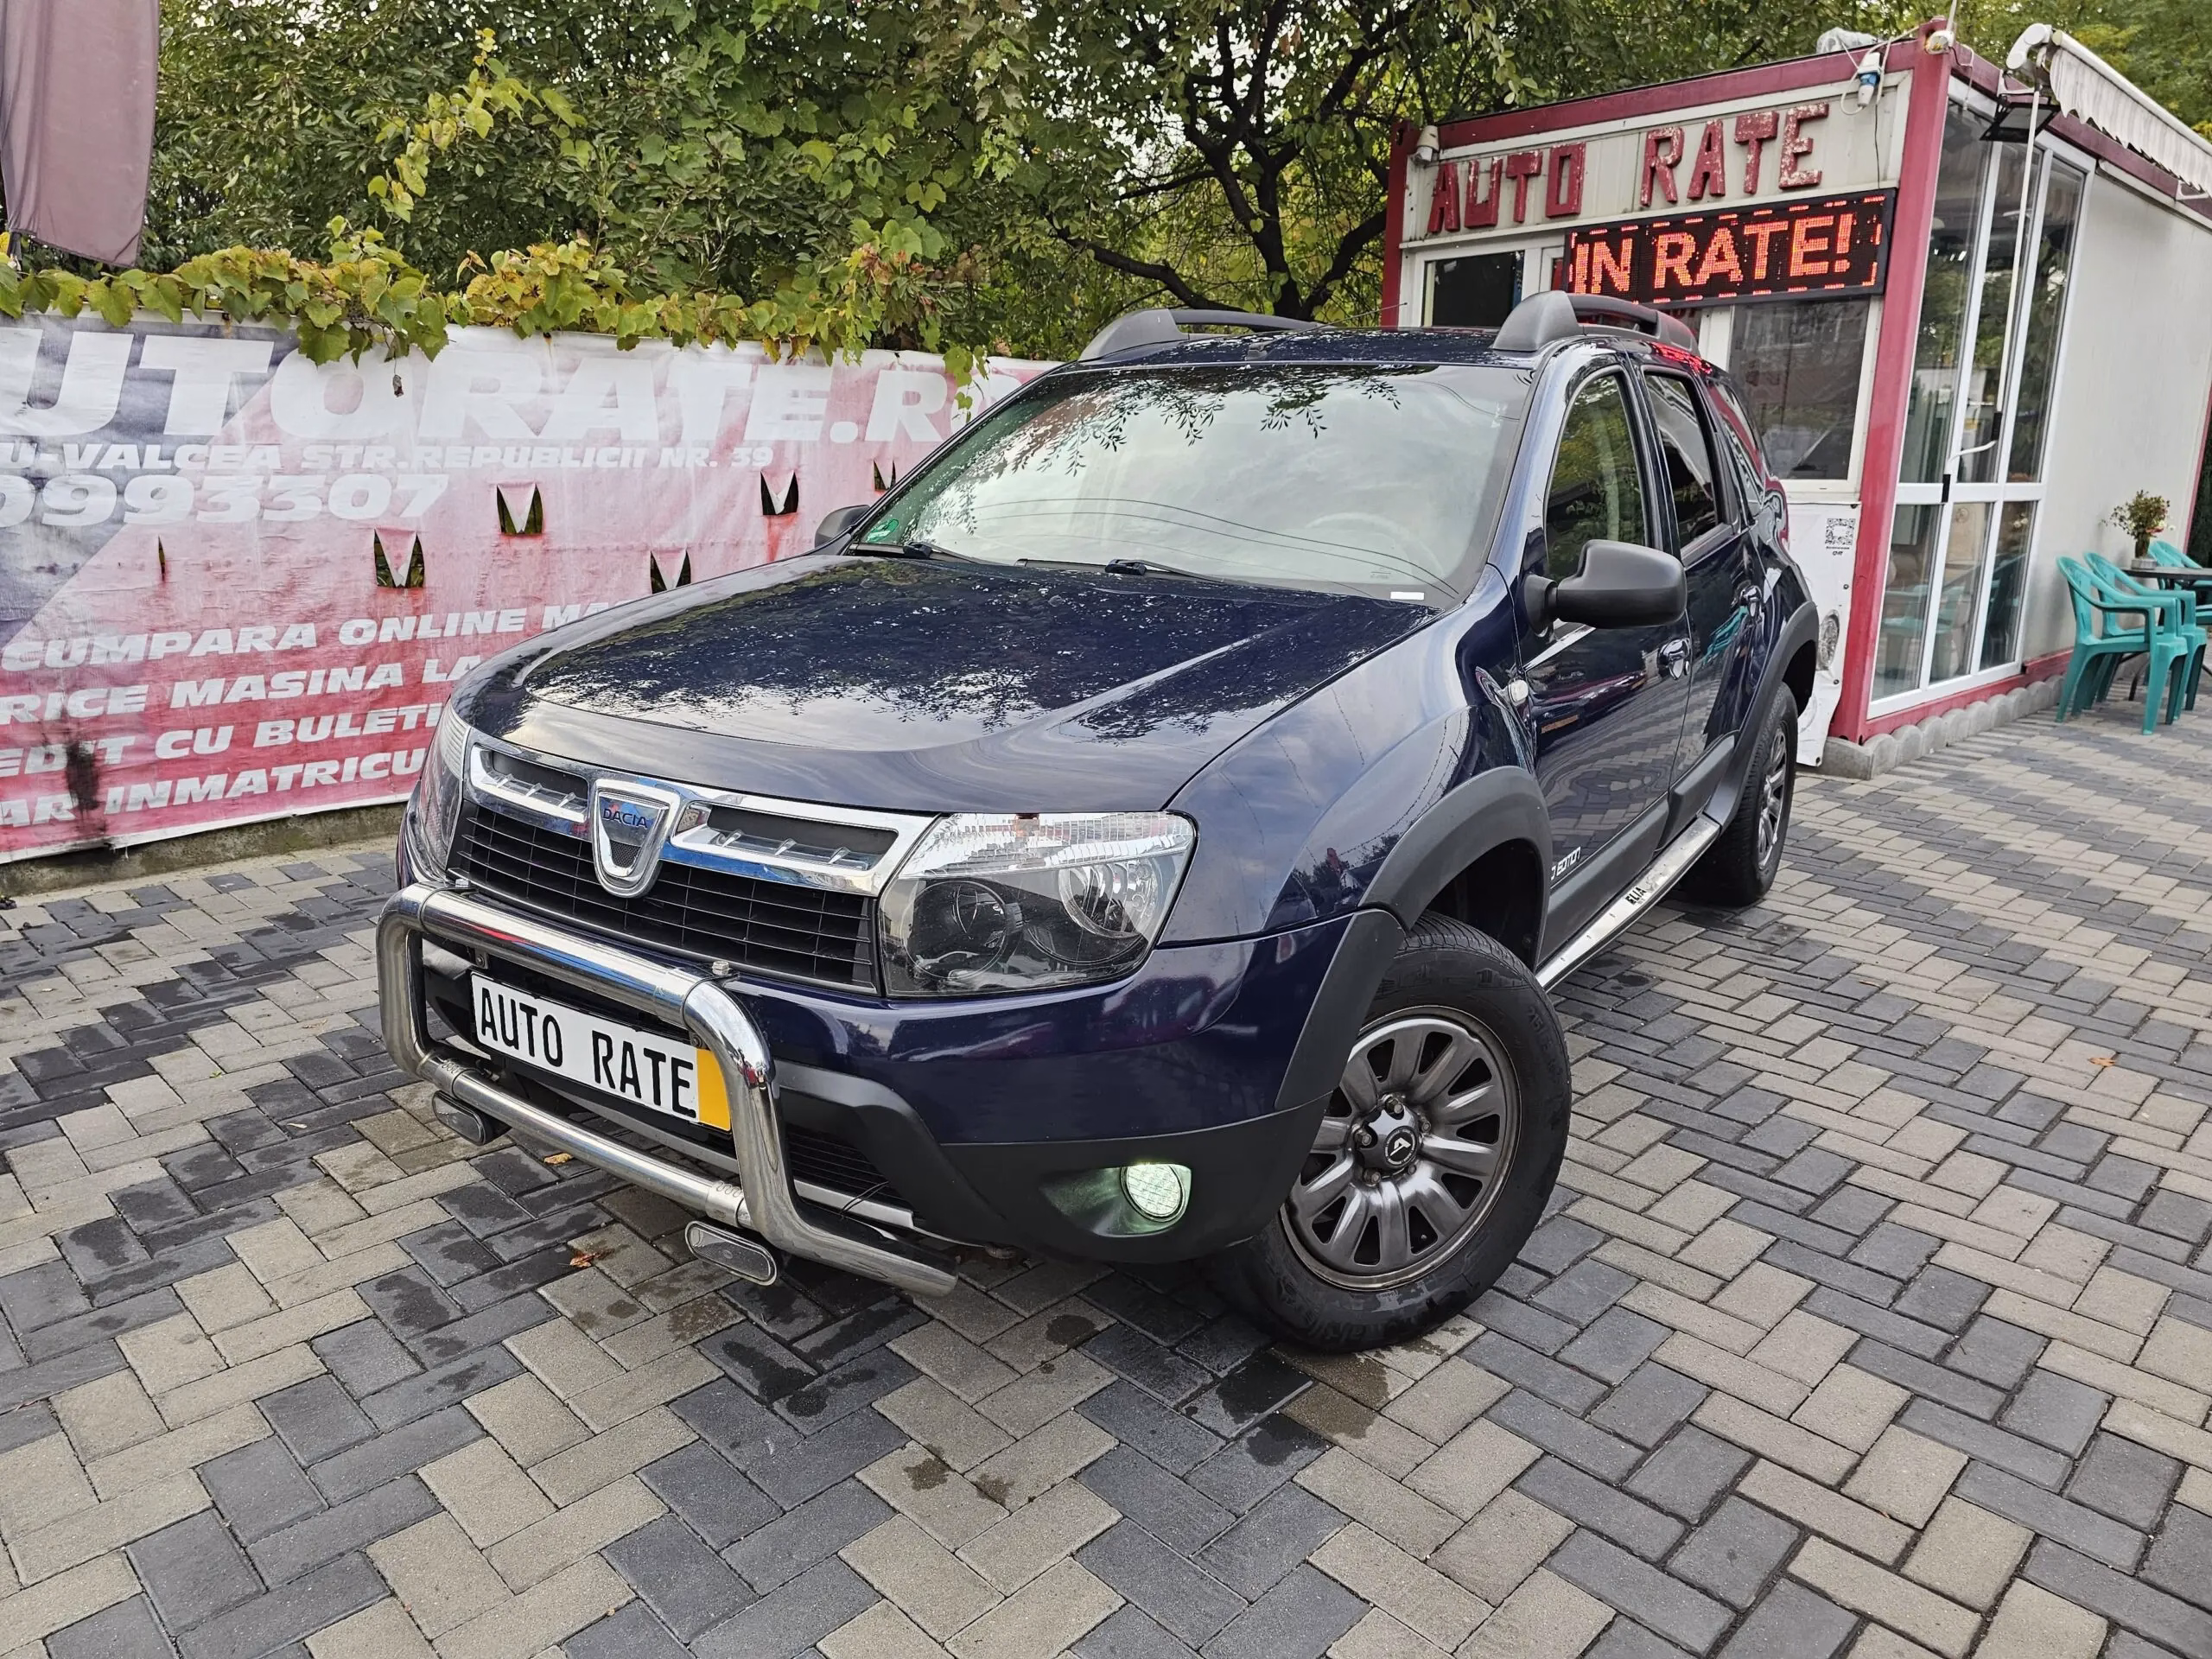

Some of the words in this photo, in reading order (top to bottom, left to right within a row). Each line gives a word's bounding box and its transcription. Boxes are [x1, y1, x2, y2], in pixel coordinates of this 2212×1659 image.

[1427, 142, 1586, 233] AUTO
[1640, 102, 1829, 207] RATE
[1573, 238, 1633, 295] IN
[1654, 213, 1854, 289] RATE!
[658, 447, 717, 469] NR.
[730, 445, 774, 467] 39
[1, 623, 317, 671] CUMPARA
[338, 607, 525, 645] ONLINE
[0, 684, 149, 726] RICE
[169, 664, 406, 709] MASINA
[422, 655, 482, 683] LA
[155, 725, 235, 760] CU
[602, 807, 648, 830] DACIA
[1624, 887, 1647, 906] ELIA
[480, 987, 564, 1068] AUTO
[592, 1030, 697, 1119] RATE
